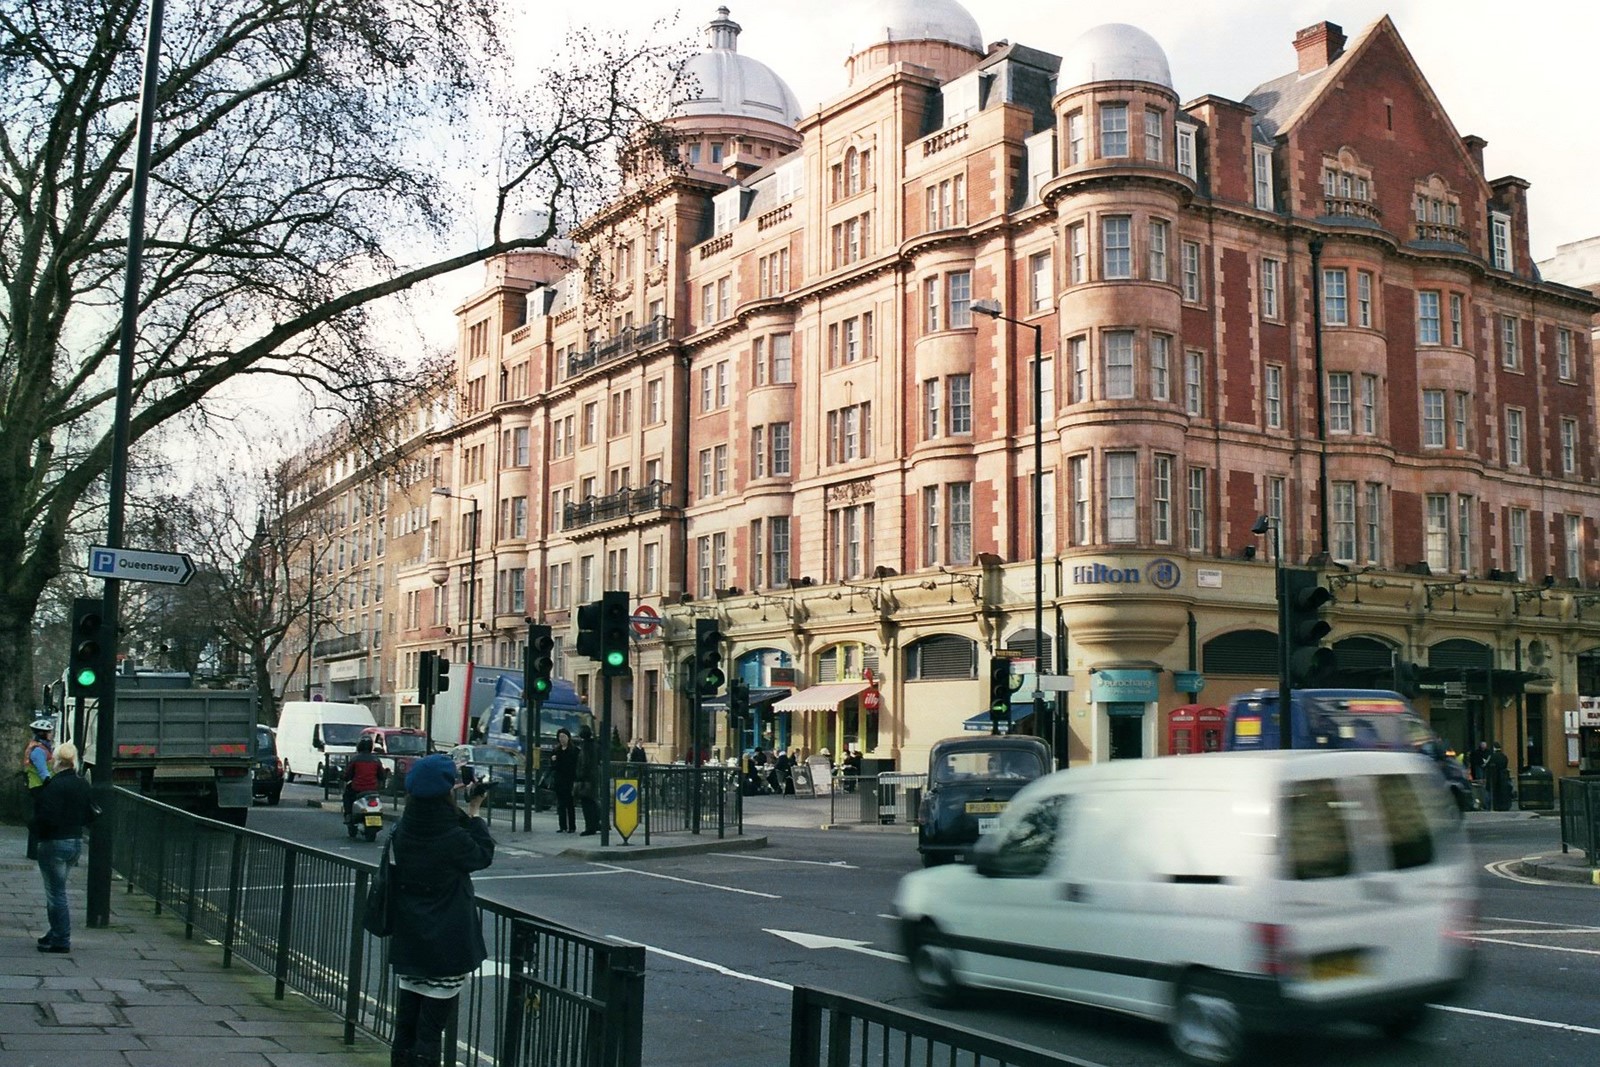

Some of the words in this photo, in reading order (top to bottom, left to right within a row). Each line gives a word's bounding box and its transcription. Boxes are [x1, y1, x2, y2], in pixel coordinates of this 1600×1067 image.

[98, 554, 113, 570] P
[119, 559, 180, 575] Queensway
[1074, 563, 1140, 584] Hilton
[864, 693, 879, 706] illy
